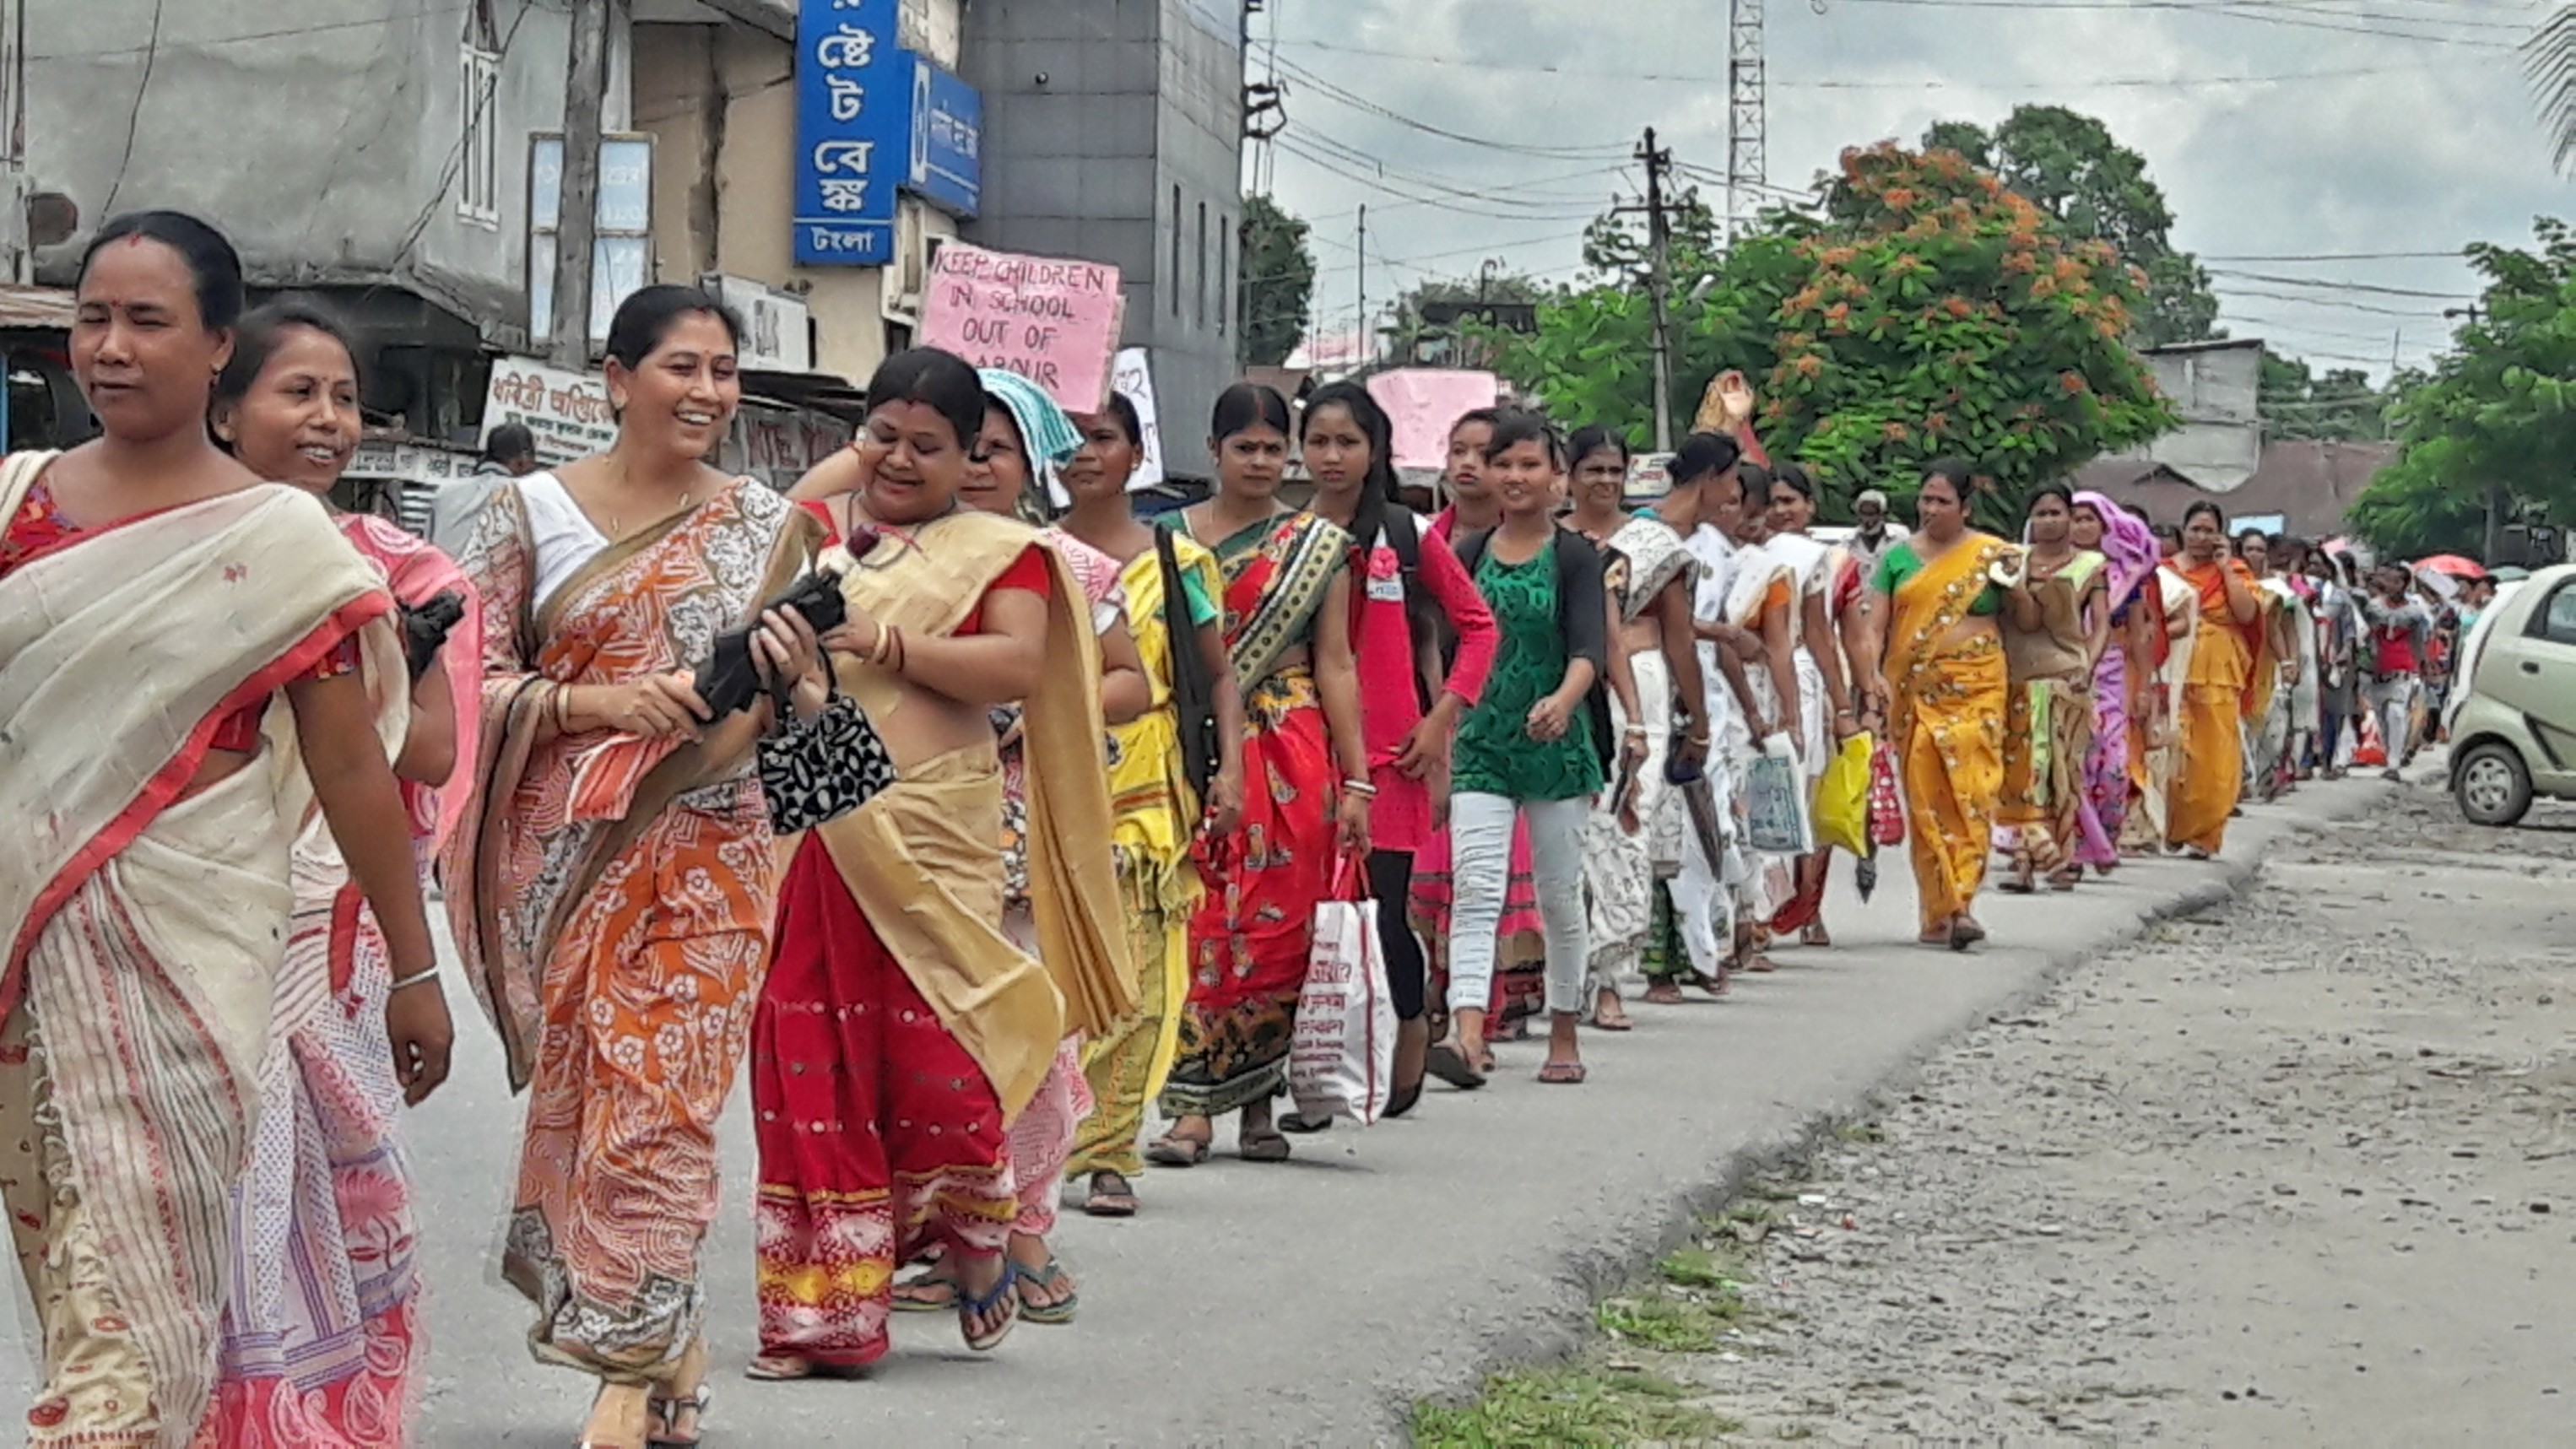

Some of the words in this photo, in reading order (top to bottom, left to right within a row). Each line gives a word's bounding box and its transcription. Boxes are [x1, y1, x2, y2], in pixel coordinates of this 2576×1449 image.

[814, 140, 874, 211] বেঙ্ক
[934, 251, 989, 279] KEEP
[994, 261, 1106, 291] CHILDREN
[950, 282, 973, 307] IN
[988, 290, 1075, 318] SCHOOL
[963, 317, 1009, 343] OUT
[1025, 325, 1058, 349] OF
